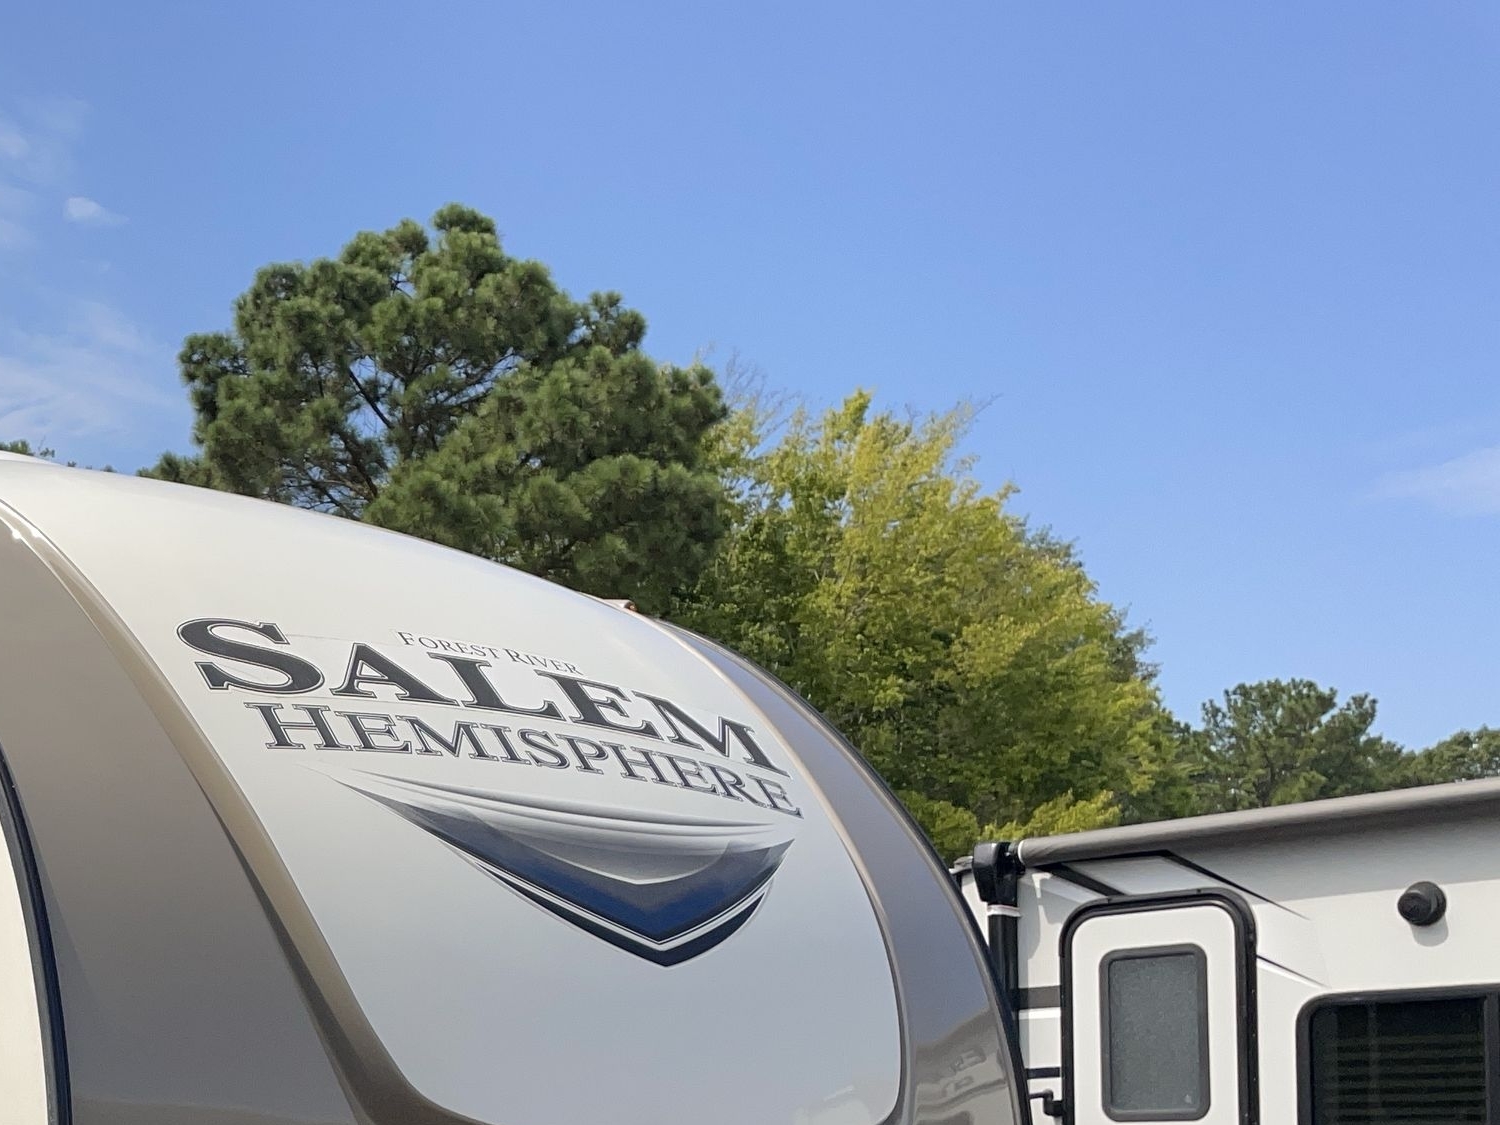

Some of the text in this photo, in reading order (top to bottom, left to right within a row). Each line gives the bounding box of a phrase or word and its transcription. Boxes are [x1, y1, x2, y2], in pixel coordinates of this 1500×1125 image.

[176, 617, 791, 778] SALEM
[397, 631, 584, 676] FOREST RIVER
[244, 702, 804, 820] HEMISPHERE
